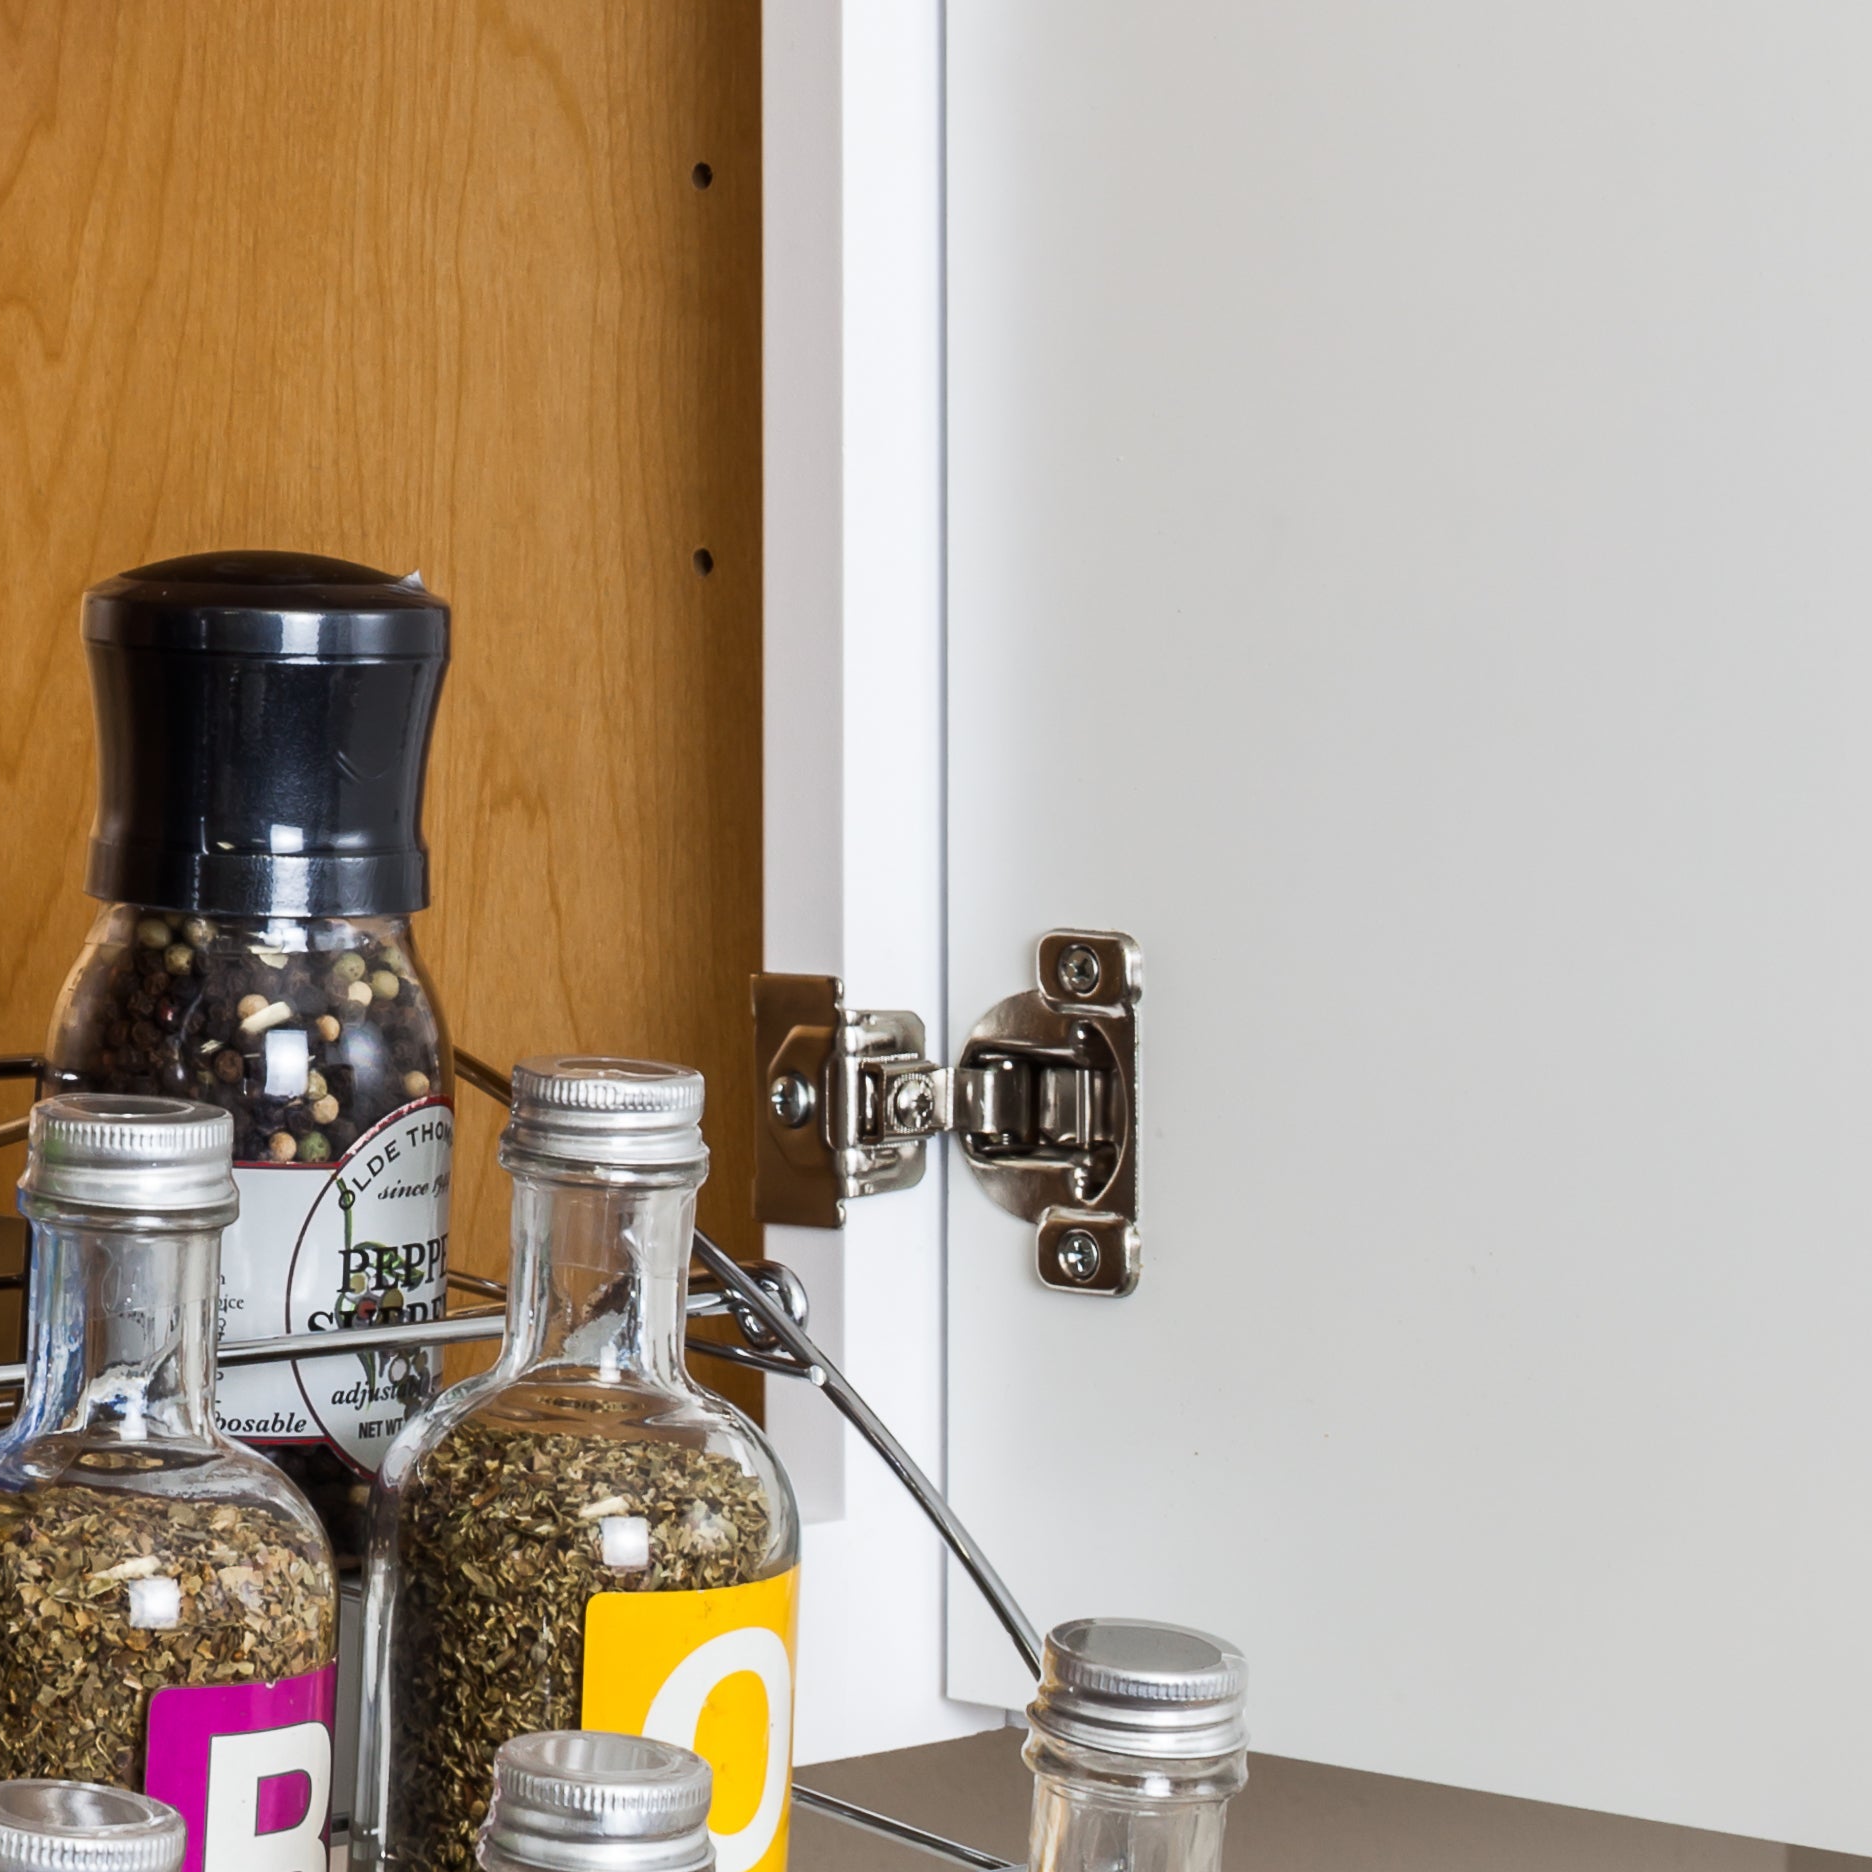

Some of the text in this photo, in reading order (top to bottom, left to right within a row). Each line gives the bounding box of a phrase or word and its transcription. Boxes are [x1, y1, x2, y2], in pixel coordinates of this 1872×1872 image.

[338, 1138, 401, 1211] OLDE
[377, 1179, 429, 1201] since
[358, 1419, 384, 1440] NET
